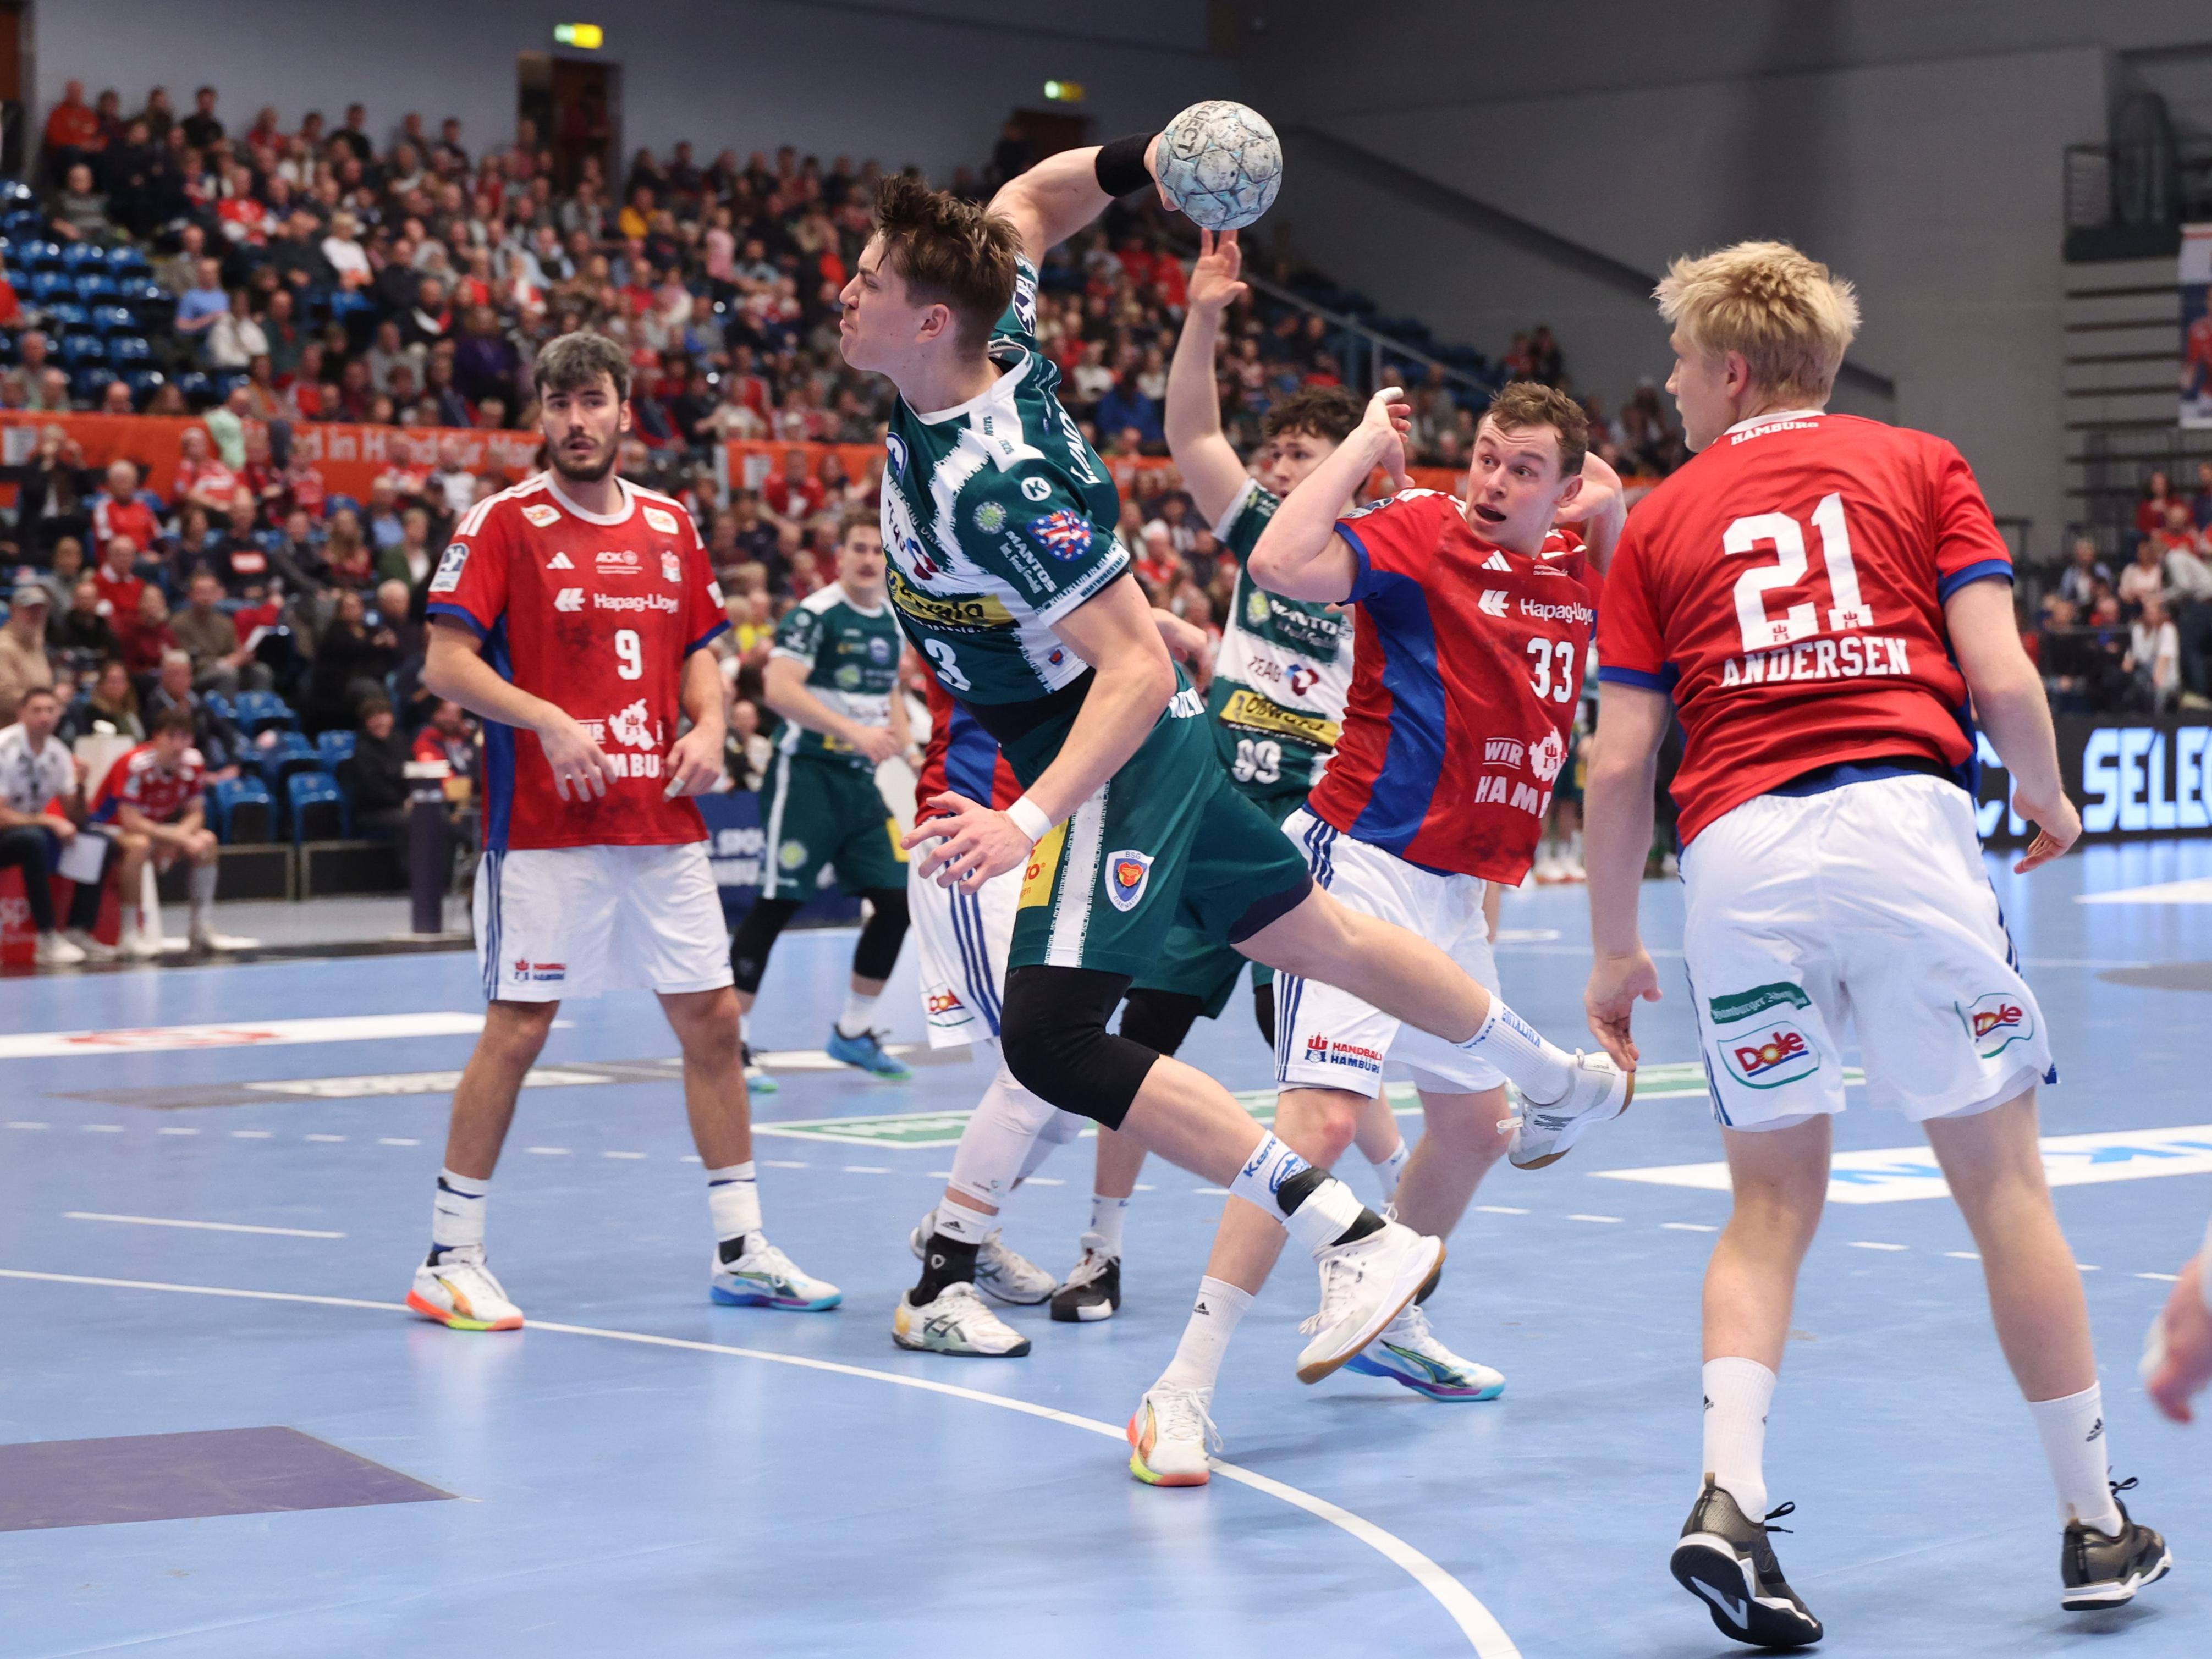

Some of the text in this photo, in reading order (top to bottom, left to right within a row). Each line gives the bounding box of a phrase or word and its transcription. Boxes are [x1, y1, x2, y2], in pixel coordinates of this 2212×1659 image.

[1004, 530, 1058, 593] MANTOS
[1722, 492, 1874, 652] 21
[614, 629, 642, 680] 9
[1527, 637, 1575, 703] 33
[1719, 637, 1911, 688] ANDERSEN
[1484, 742, 1524, 766] WIR
[1125, 851, 1141, 859] BSG
[1113, 895, 1138, 909] EISENACH
[1973, 1002, 2023, 1039] Dole
[1734, 1030, 1806, 1072] Dole
